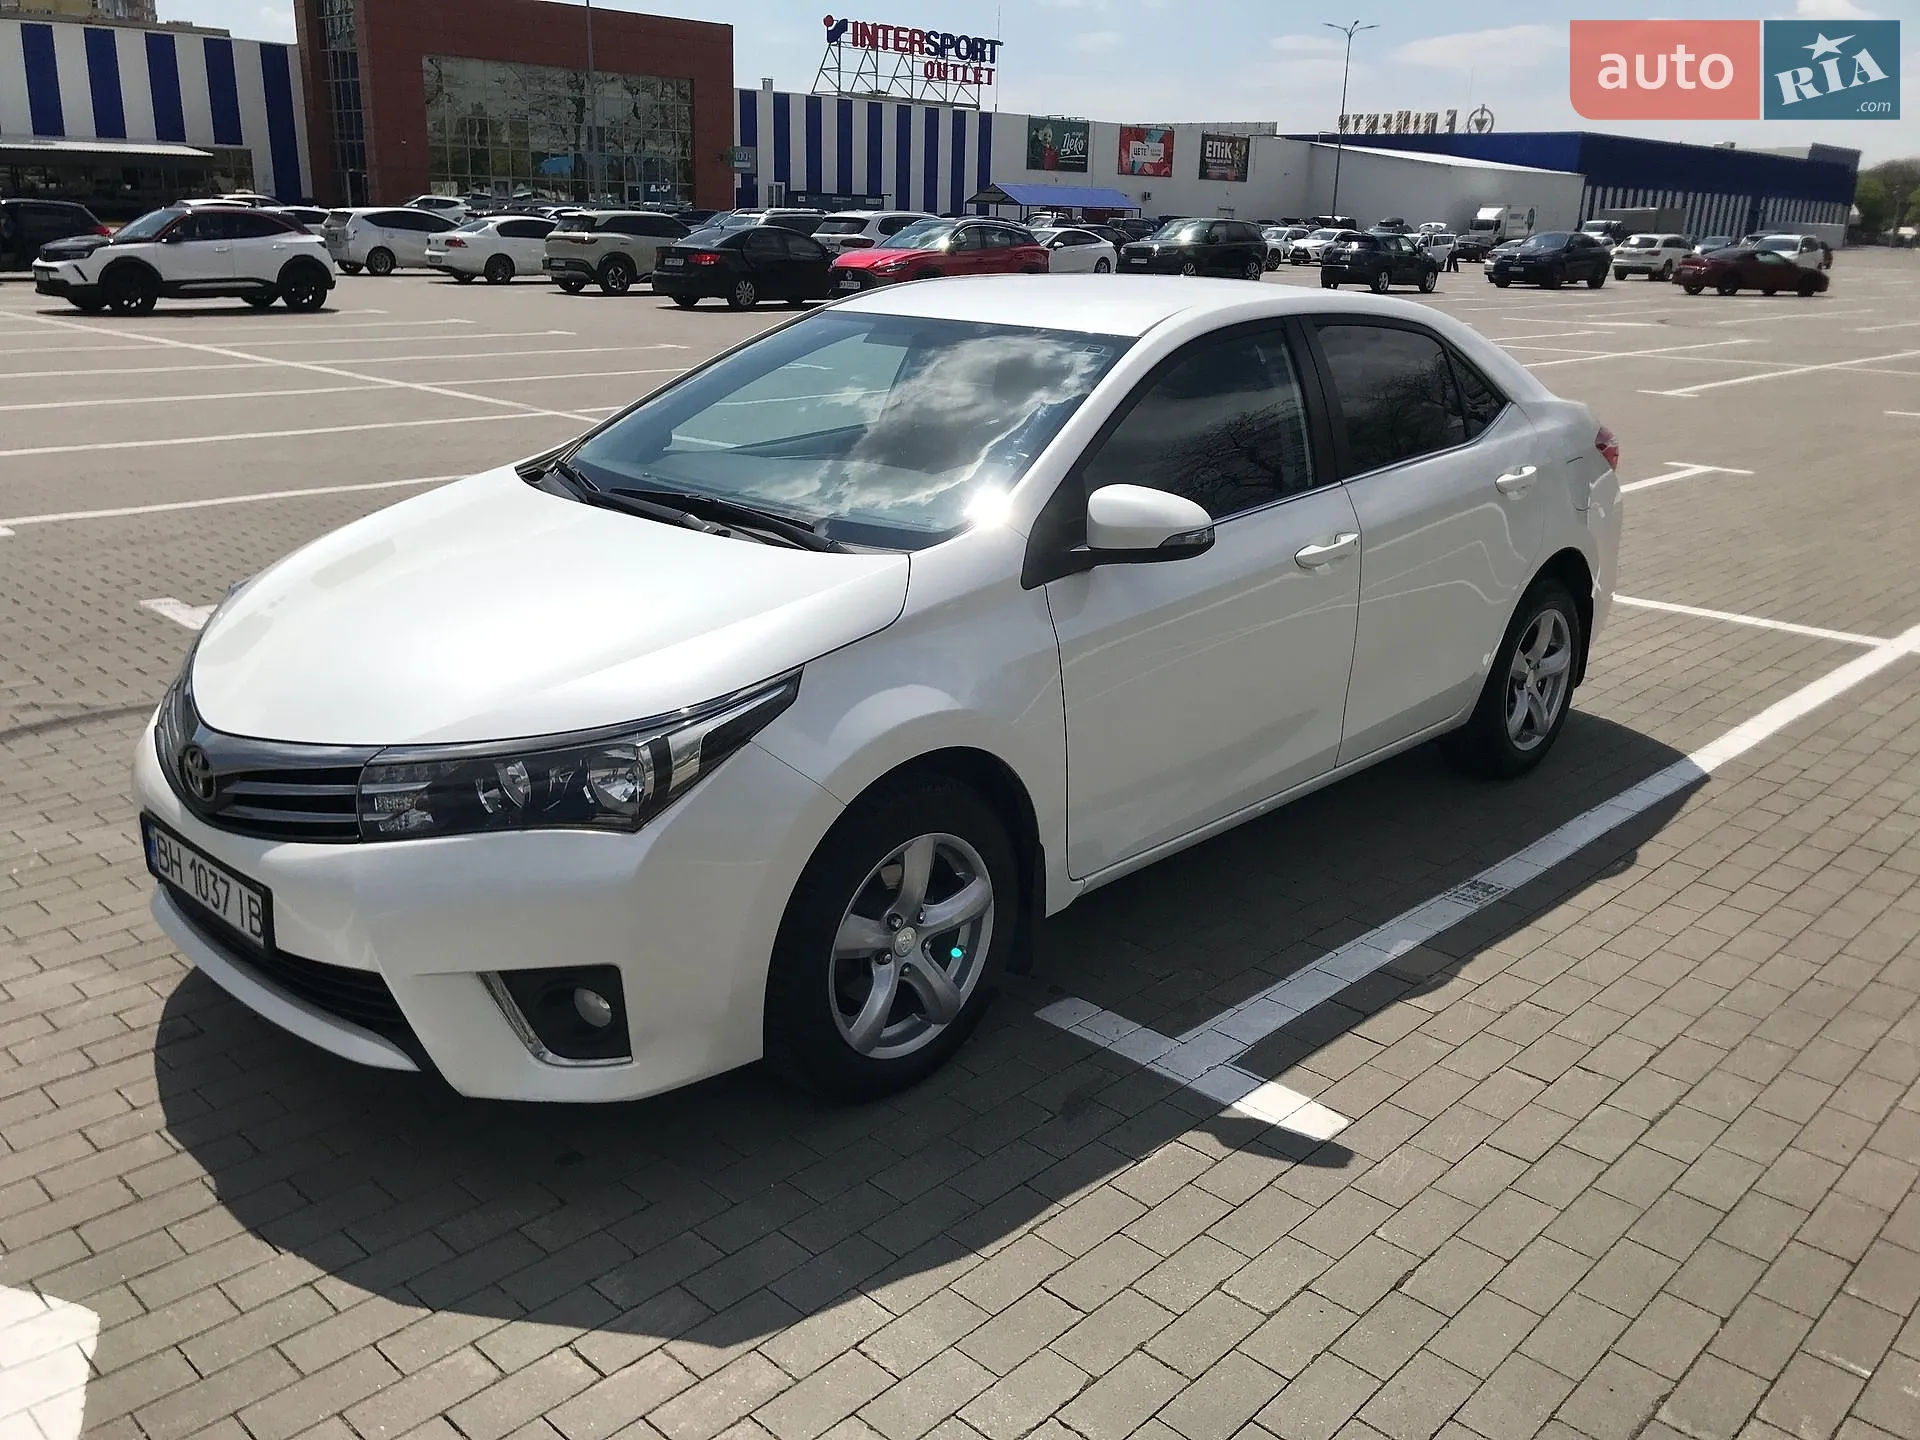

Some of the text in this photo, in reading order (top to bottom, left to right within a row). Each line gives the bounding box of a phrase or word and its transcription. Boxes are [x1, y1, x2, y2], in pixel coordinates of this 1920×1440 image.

[852, 20, 1001, 64] INTERSPORT
[923, 60, 996, 85] OUTLET
[156, 832, 184, 886] BH
[188, 855, 231, 917] 1037
[238, 886, 264, 939] IB
